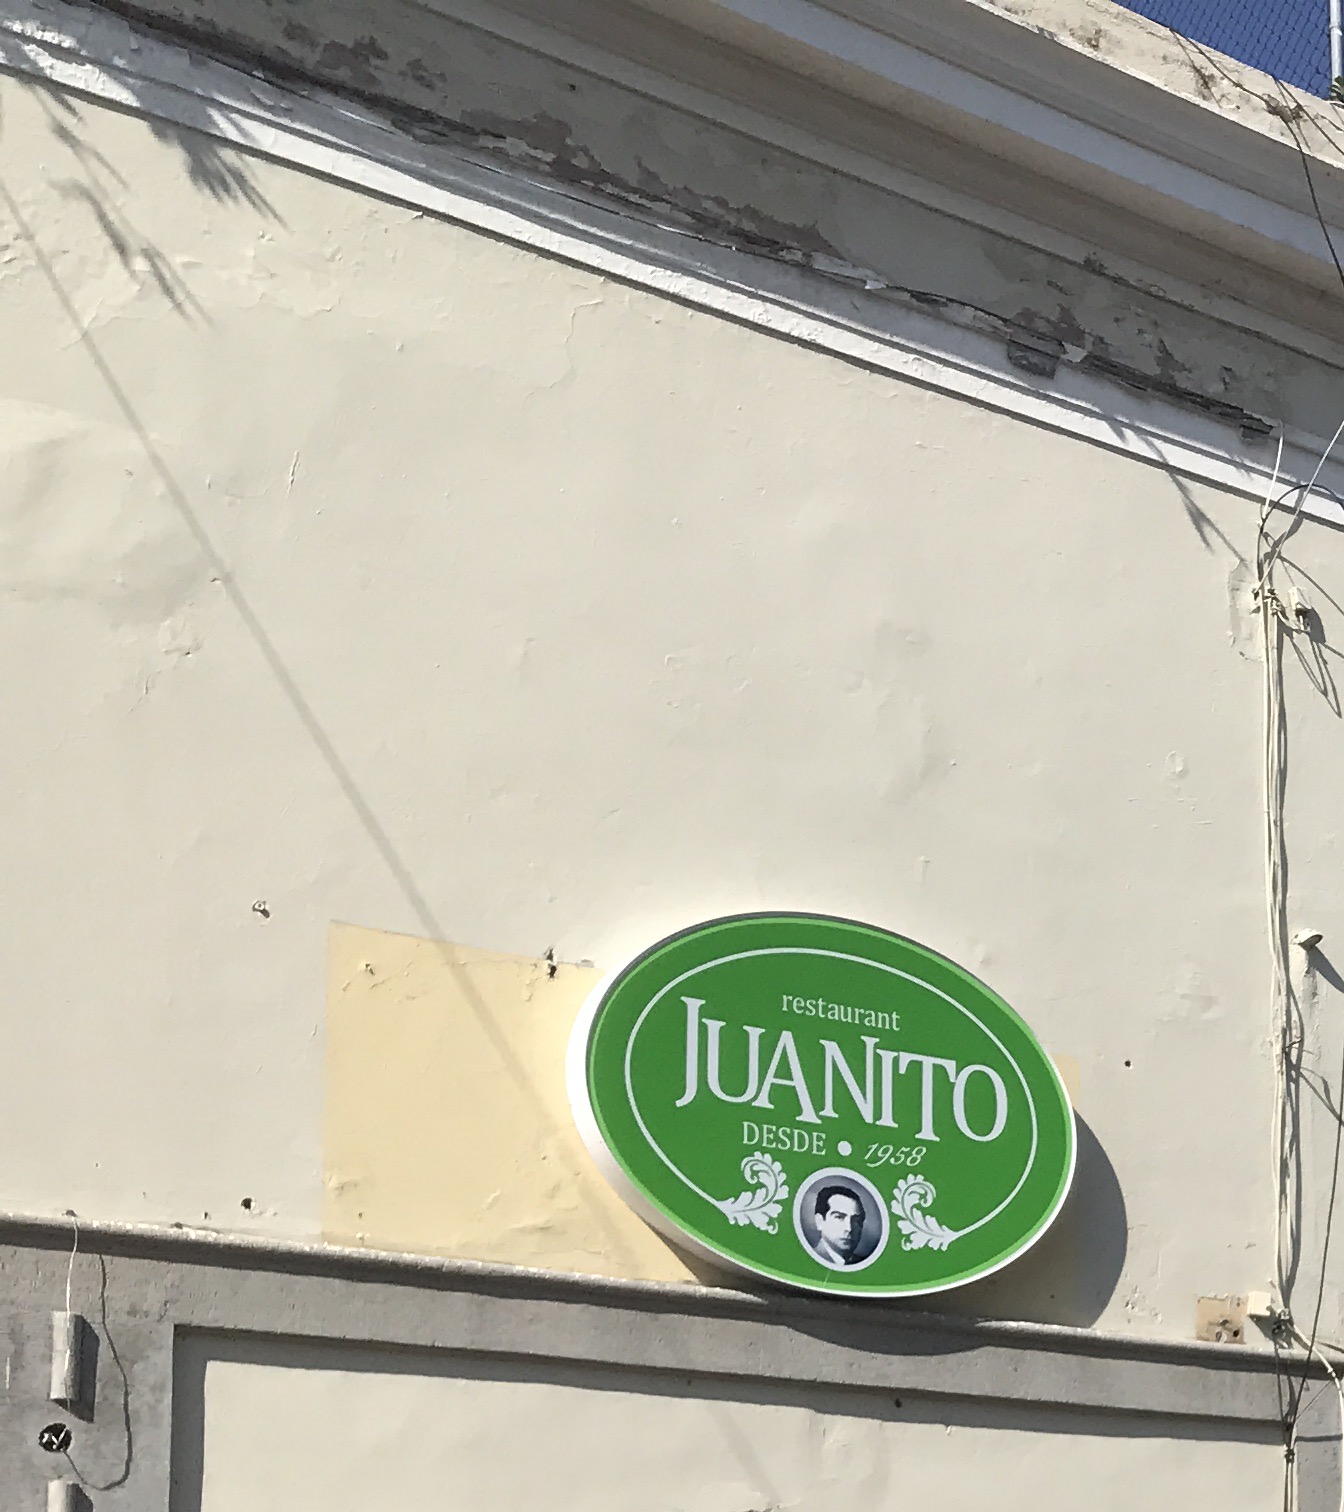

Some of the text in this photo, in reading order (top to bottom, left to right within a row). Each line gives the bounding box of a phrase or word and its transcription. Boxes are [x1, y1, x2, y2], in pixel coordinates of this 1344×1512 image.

[782, 994, 900, 1032] restaurant
[675, 995, 1008, 1142] JUANITO
[742, 1121, 927, 1168] DESDE 1958
